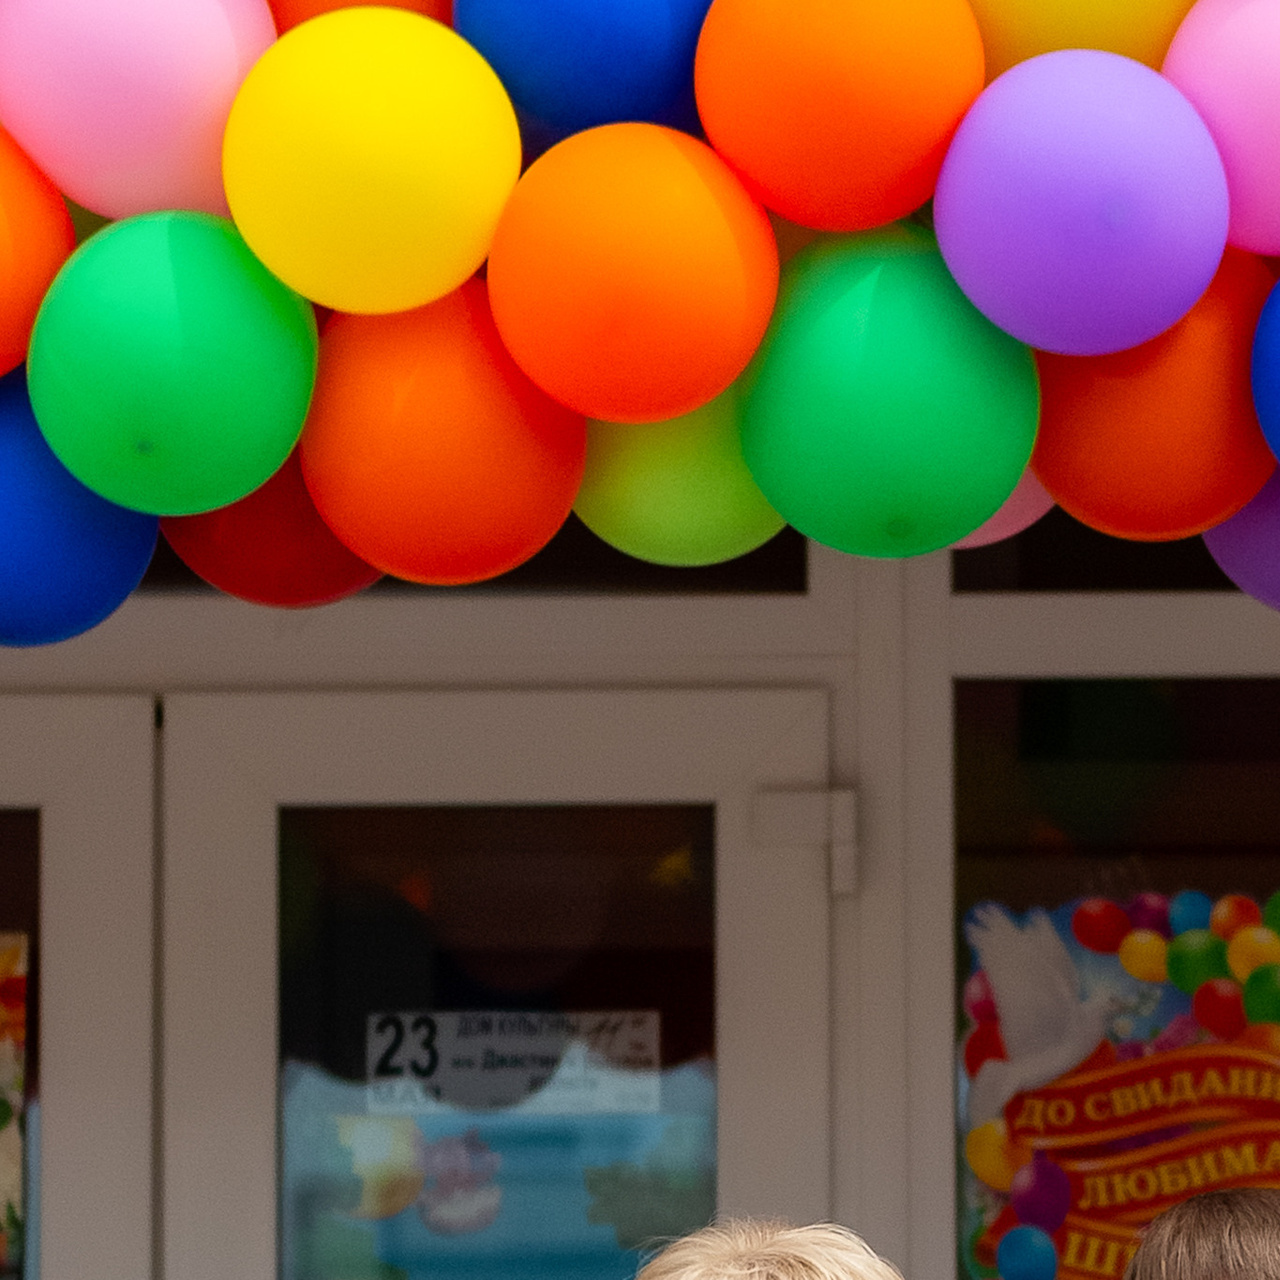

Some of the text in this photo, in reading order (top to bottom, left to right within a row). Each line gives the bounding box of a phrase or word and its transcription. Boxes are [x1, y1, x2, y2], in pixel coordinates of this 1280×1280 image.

[374, 1015, 439, 1078] 23
[1013, 1097, 1076, 1132] ДО
[1063, 1231, 1138, 1277] Ш
